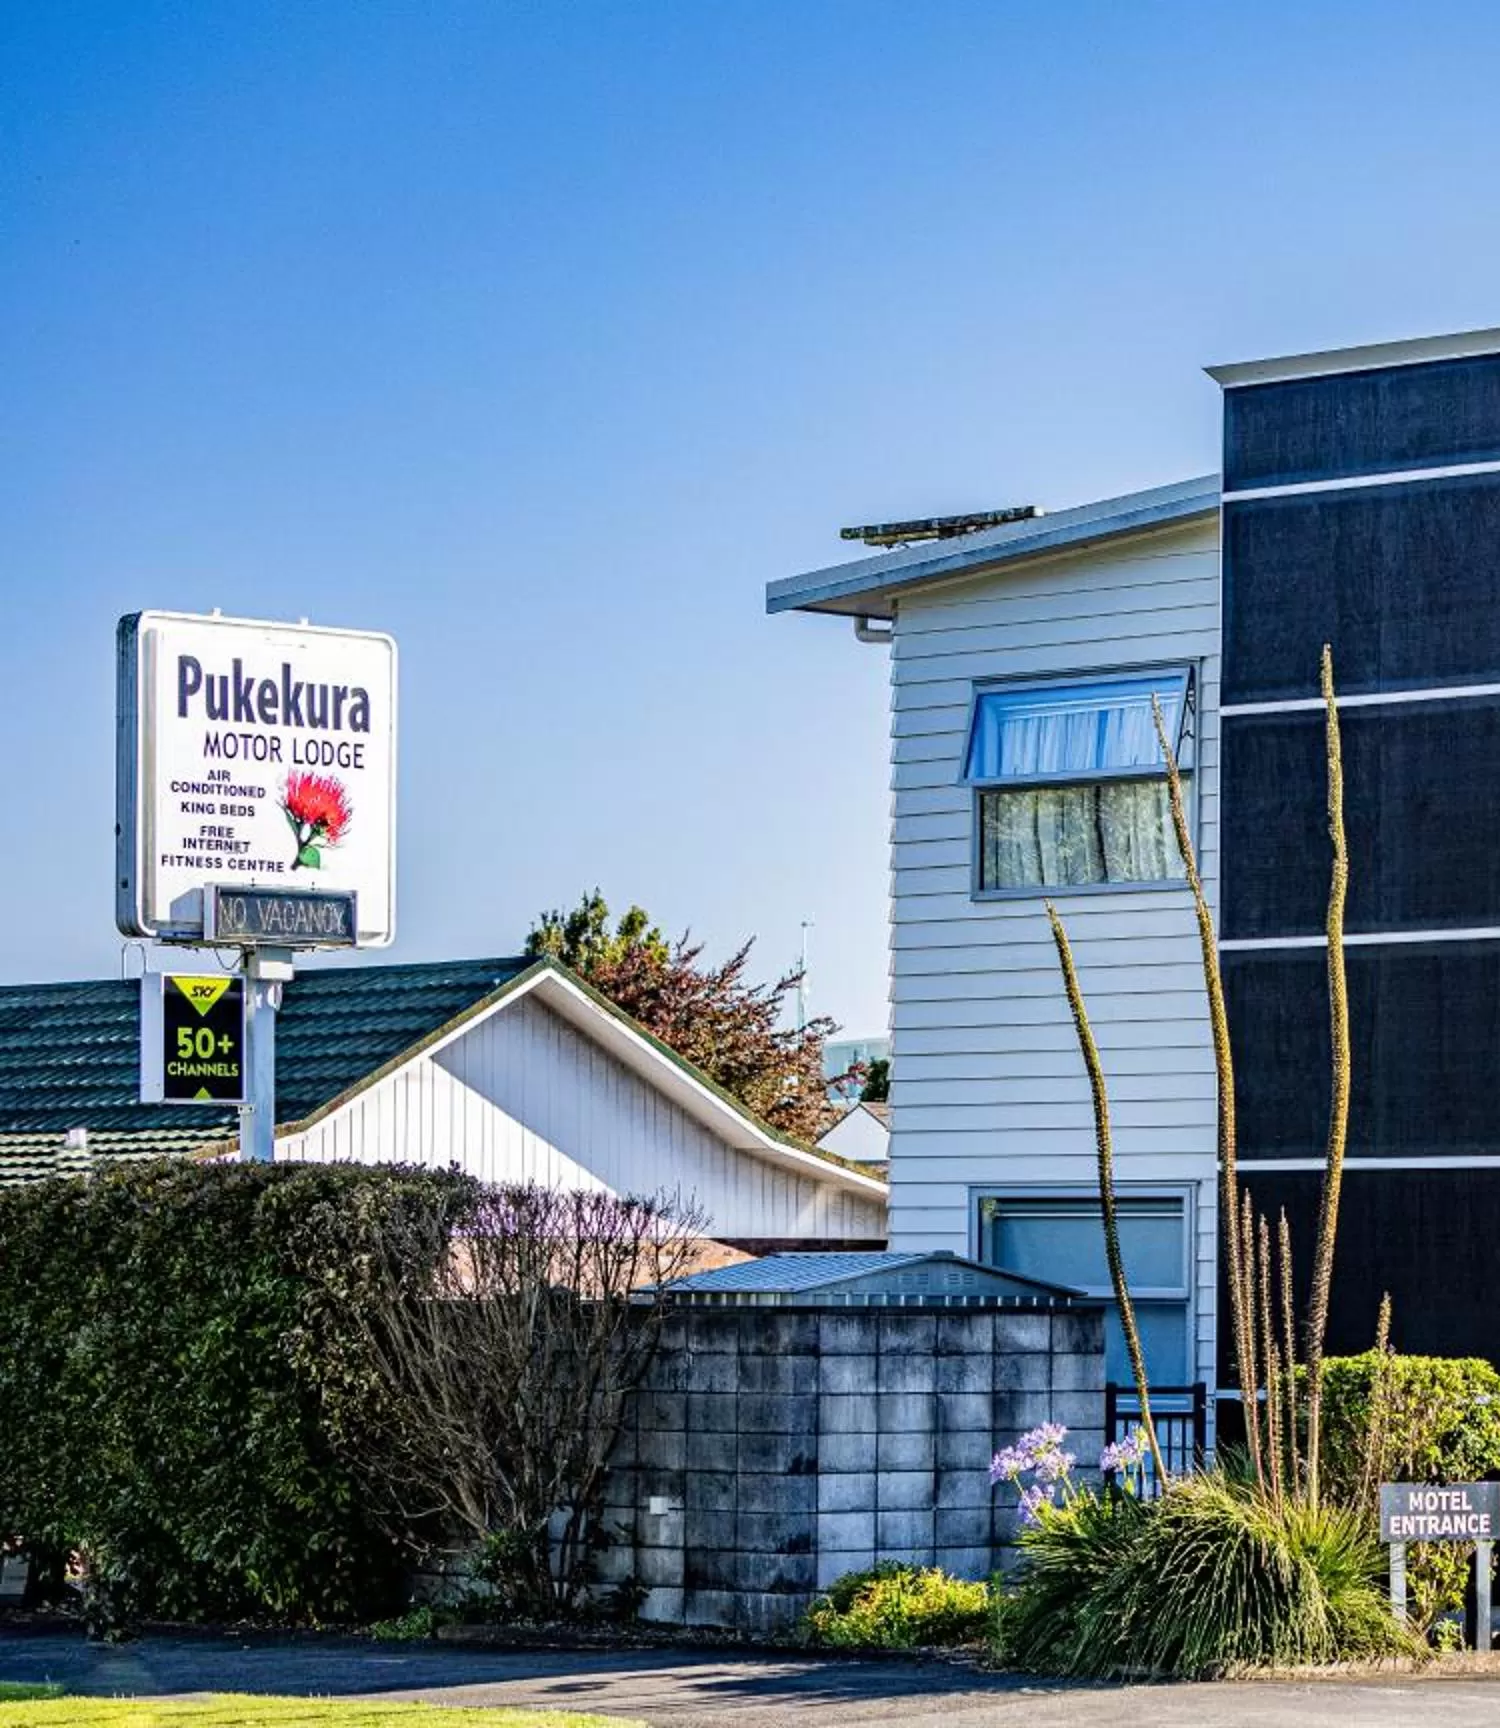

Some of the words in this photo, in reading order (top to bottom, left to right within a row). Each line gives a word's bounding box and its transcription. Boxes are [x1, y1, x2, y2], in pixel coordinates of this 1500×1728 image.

[177, 654, 371, 734] Pukekura
[203, 730, 283, 764] MOTOR
[292, 736, 366, 770] LODGE
[207, 769, 231, 783] AIR
[170, 780, 267, 799] CONDITIONED
[180, 801, 216, 816] KING
[219, 803, 256, 818] BEDS
[200, 825, 235, 839] FREE
[183, 837, 252, 855] INTERNET
[161, 854, 223, 870] FITNESS
[227, 857, 285, 873] CENTRE
[218, 897, 247, 934] NO
[256, 898, 346, 935] VACANCY
[191, 984, 217, 999] SKY
[177, 1027, 234, 1060] 50+
[167, 1061, 239, 1077] CHANNELS
[1408, 1491, 1472, 1511] MOTEL
[1390, 1513, 1491, 1536] ENTRANCE
